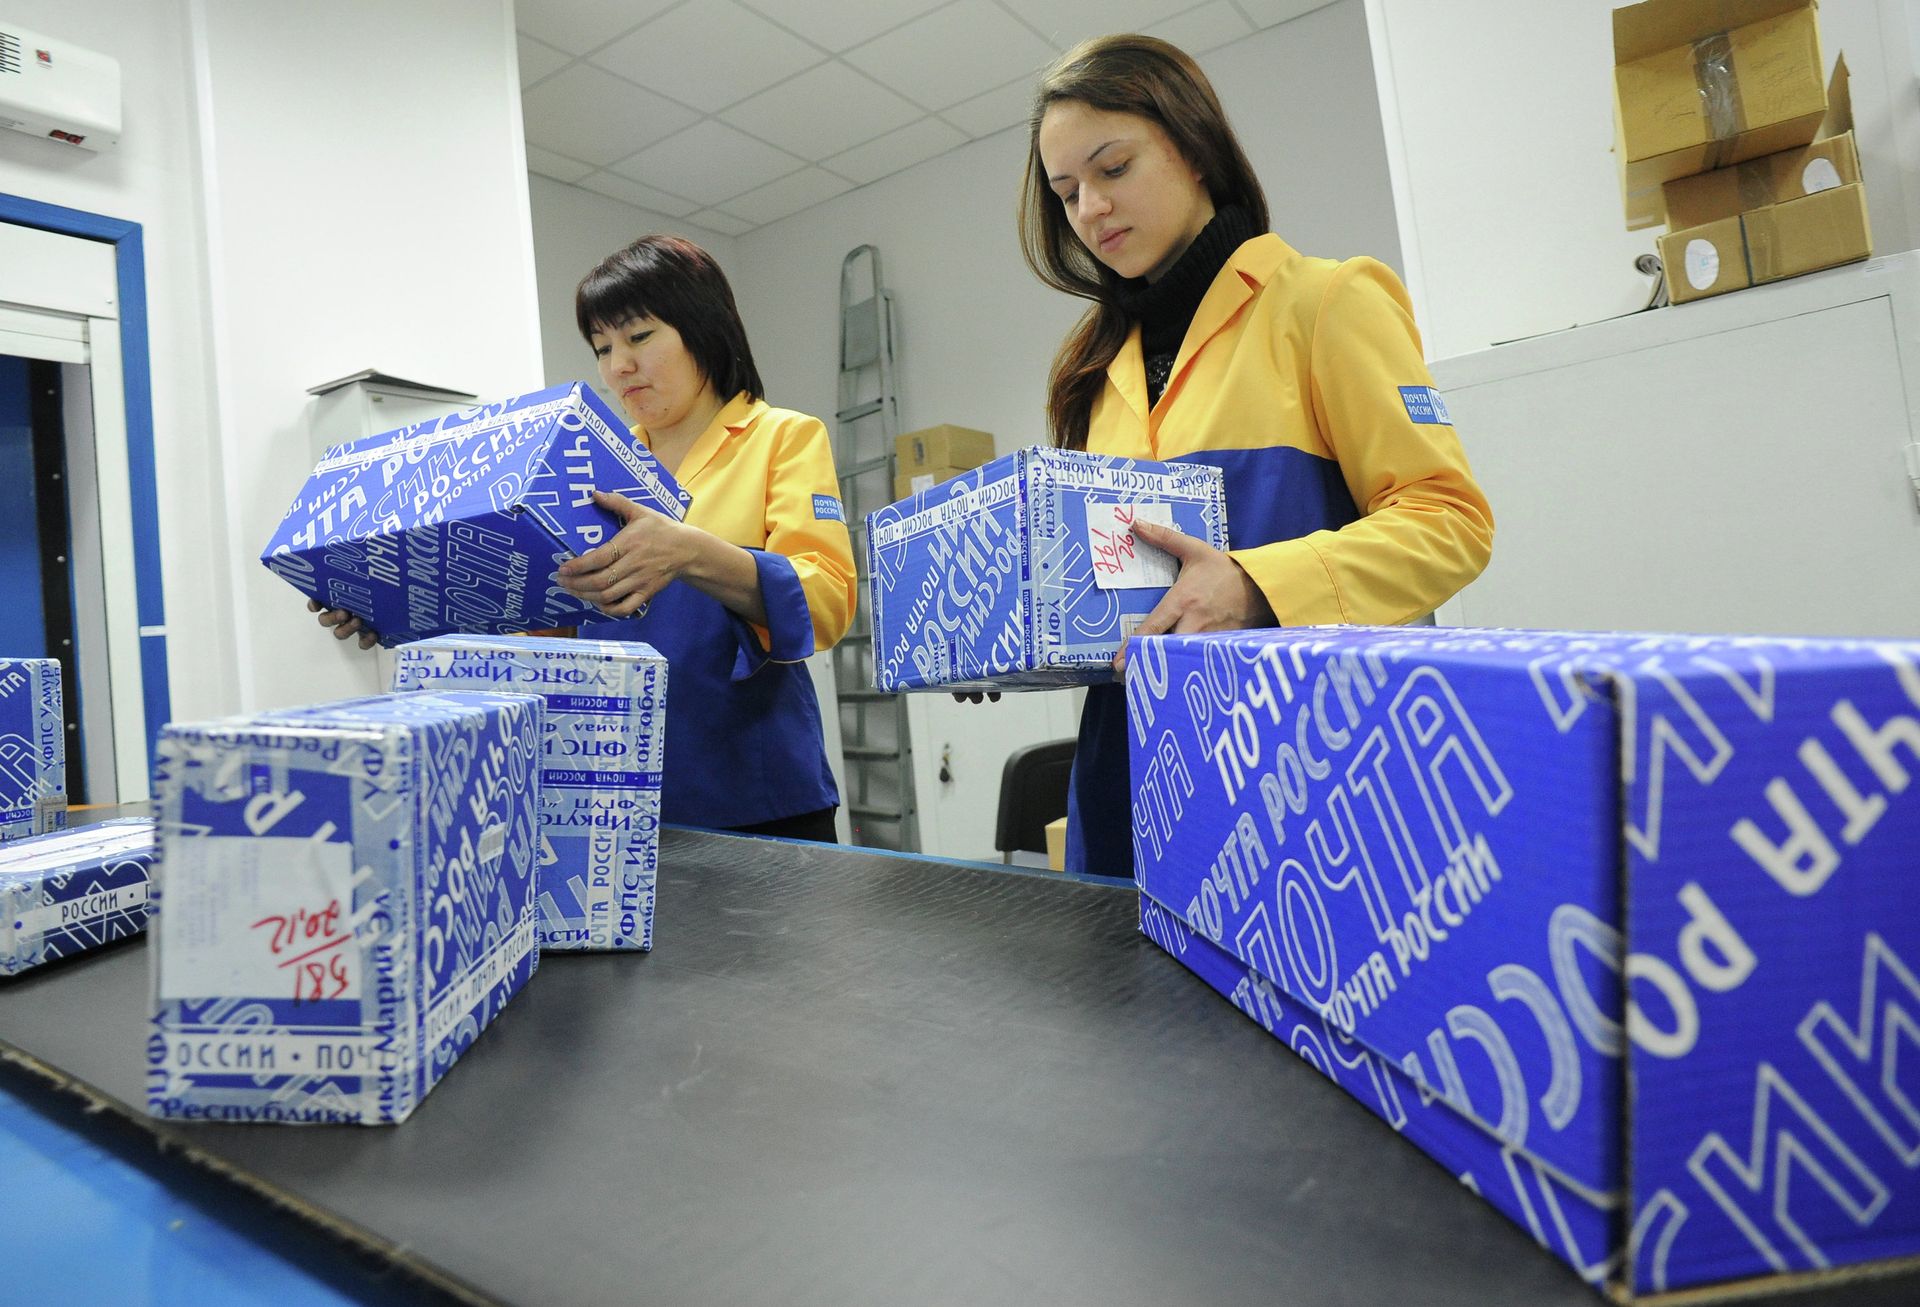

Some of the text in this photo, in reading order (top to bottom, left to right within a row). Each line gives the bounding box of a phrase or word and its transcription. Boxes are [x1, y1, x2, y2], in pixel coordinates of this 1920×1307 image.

[1403, 393, 1429, 403] ПОЧТА
[1408, 405, 1434, 415] РОССИИ
[579, 402, 607, 435] ПОЧТА
[441, 464, 492, 508] ПОЧТА
[496, 410, 561, 464] РОССИИ
[556, 406, 598, 508] ОЧТА
[616, 441, 648, 478] РОССИИ
[653, 480, 678, 510] ПОЧТА
[1111, 471, 1163, 491] РОССИИ
[1170, 472, 1212, 490] област
[814, 499, 837, 508] ПОЧТА
[875, 478, 1016, 547] РОССИИ ПОЧТА РОССИИ ПОЧТ
[1045, 474, 1055, 539] бласти
[508, 551, 529, 593] РОССИИ
[905, 565, 940, 635] ПОЧТА
[1048, 599, 1062, 646] УФП
[416, 661, 513, 683] Иркутс
[883, 632, 911, 692] РОСС
[1047, 651, 1117, 668] Свердлов
[570, 698, 609, 708] РОССИИ
[575, 723, 630, 734] илиал
[41, 721, 55, 772] УФПС
[562, 738, 628, 757] ФПС
[549, 771, 626, 783] ПОЧТА РОССИИ
[542, 808, 632, 831] Иркутс
[575, 798, 635, 809] ФГУП
[1235, 664, 1514, 1011] ПОЧТА
[1186, 811, 1271, 942] ПОЧТА
[62, 890, 118, 922] РОССИИ
[620, 873, 640, 937] ФПС
[1390, 832, 1502, 977] РОССИИ
[591, 900, 609, 945] ОЧТА
[294, 952, 349, 1008] 581
[176, 1041, 277, 1069] ОССИИ
